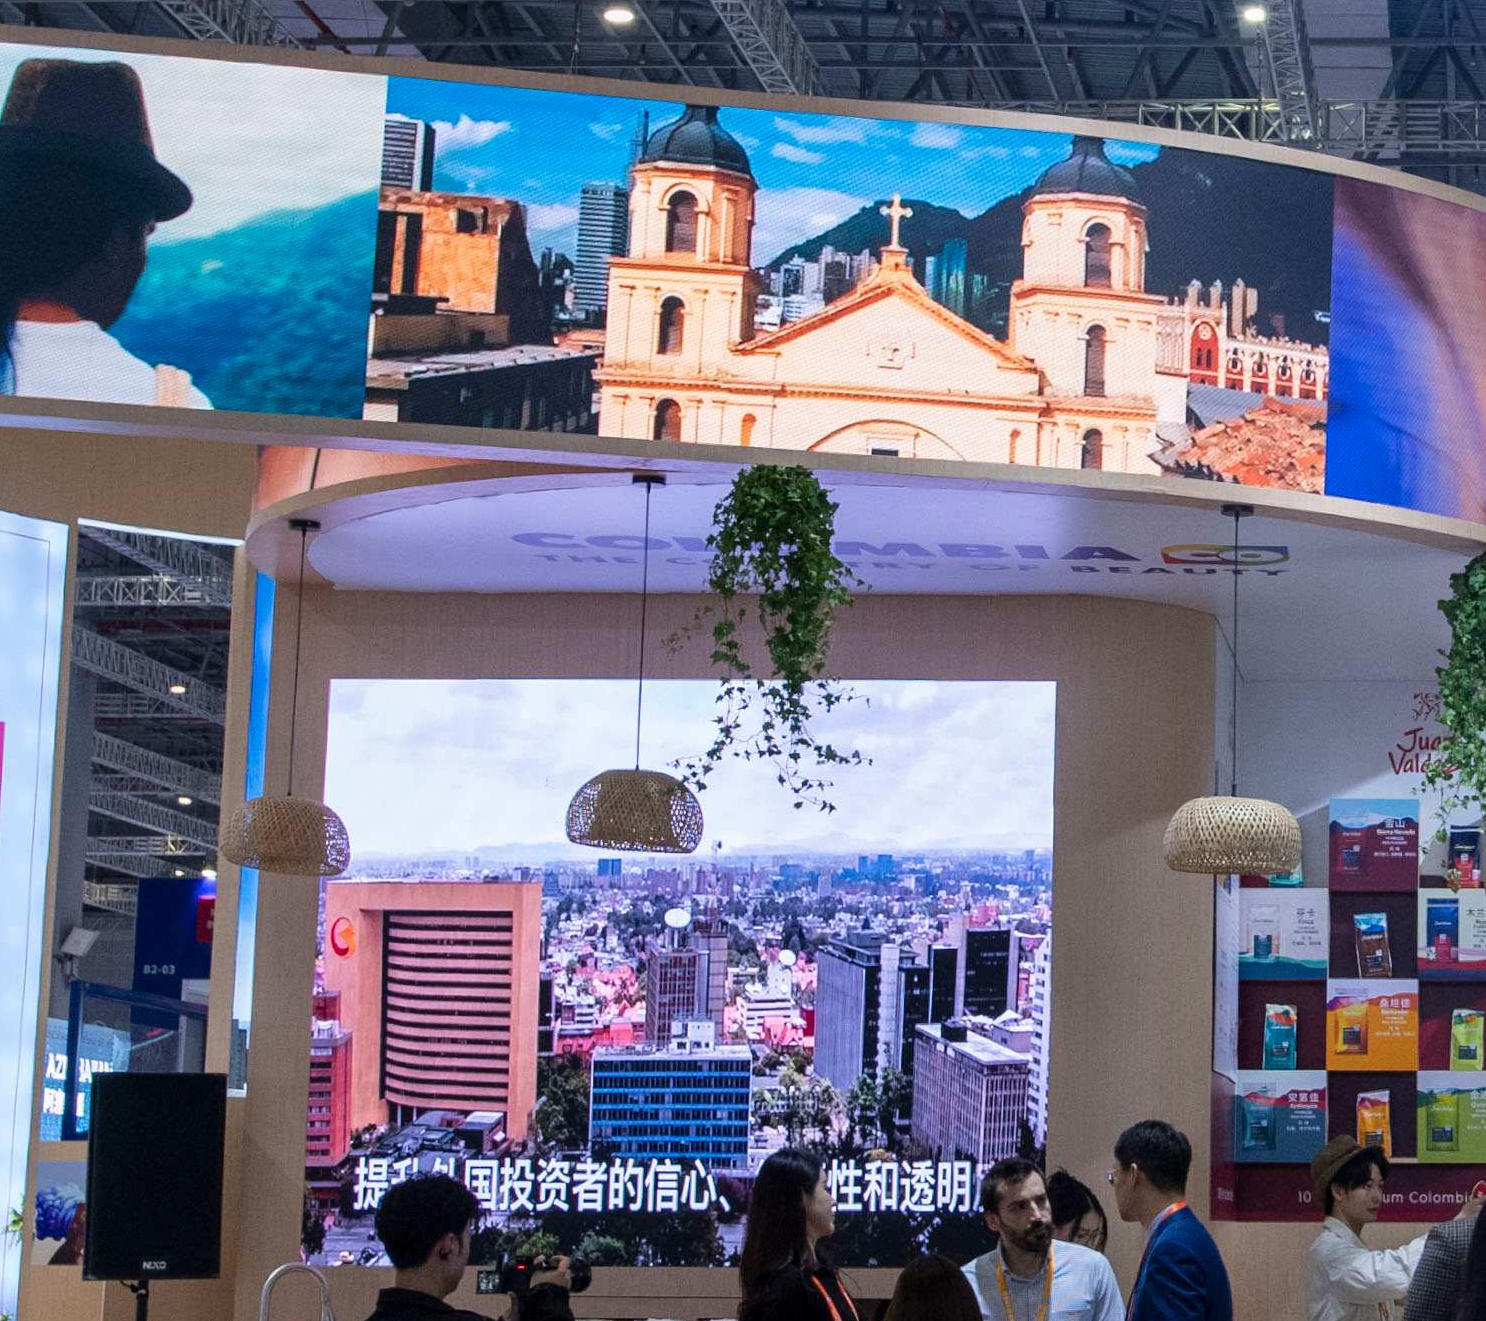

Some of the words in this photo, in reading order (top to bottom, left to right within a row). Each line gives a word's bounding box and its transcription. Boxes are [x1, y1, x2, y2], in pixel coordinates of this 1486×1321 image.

[512, 532, 1141, 562] COLMBIA
[1070, 564, 1291, 577] BEAUTY
[143, 964, 176, 975] B2-03
[1298, 1190, 1312, 1204] 10
[1409, 1190, 1473, 1205] Colombi
